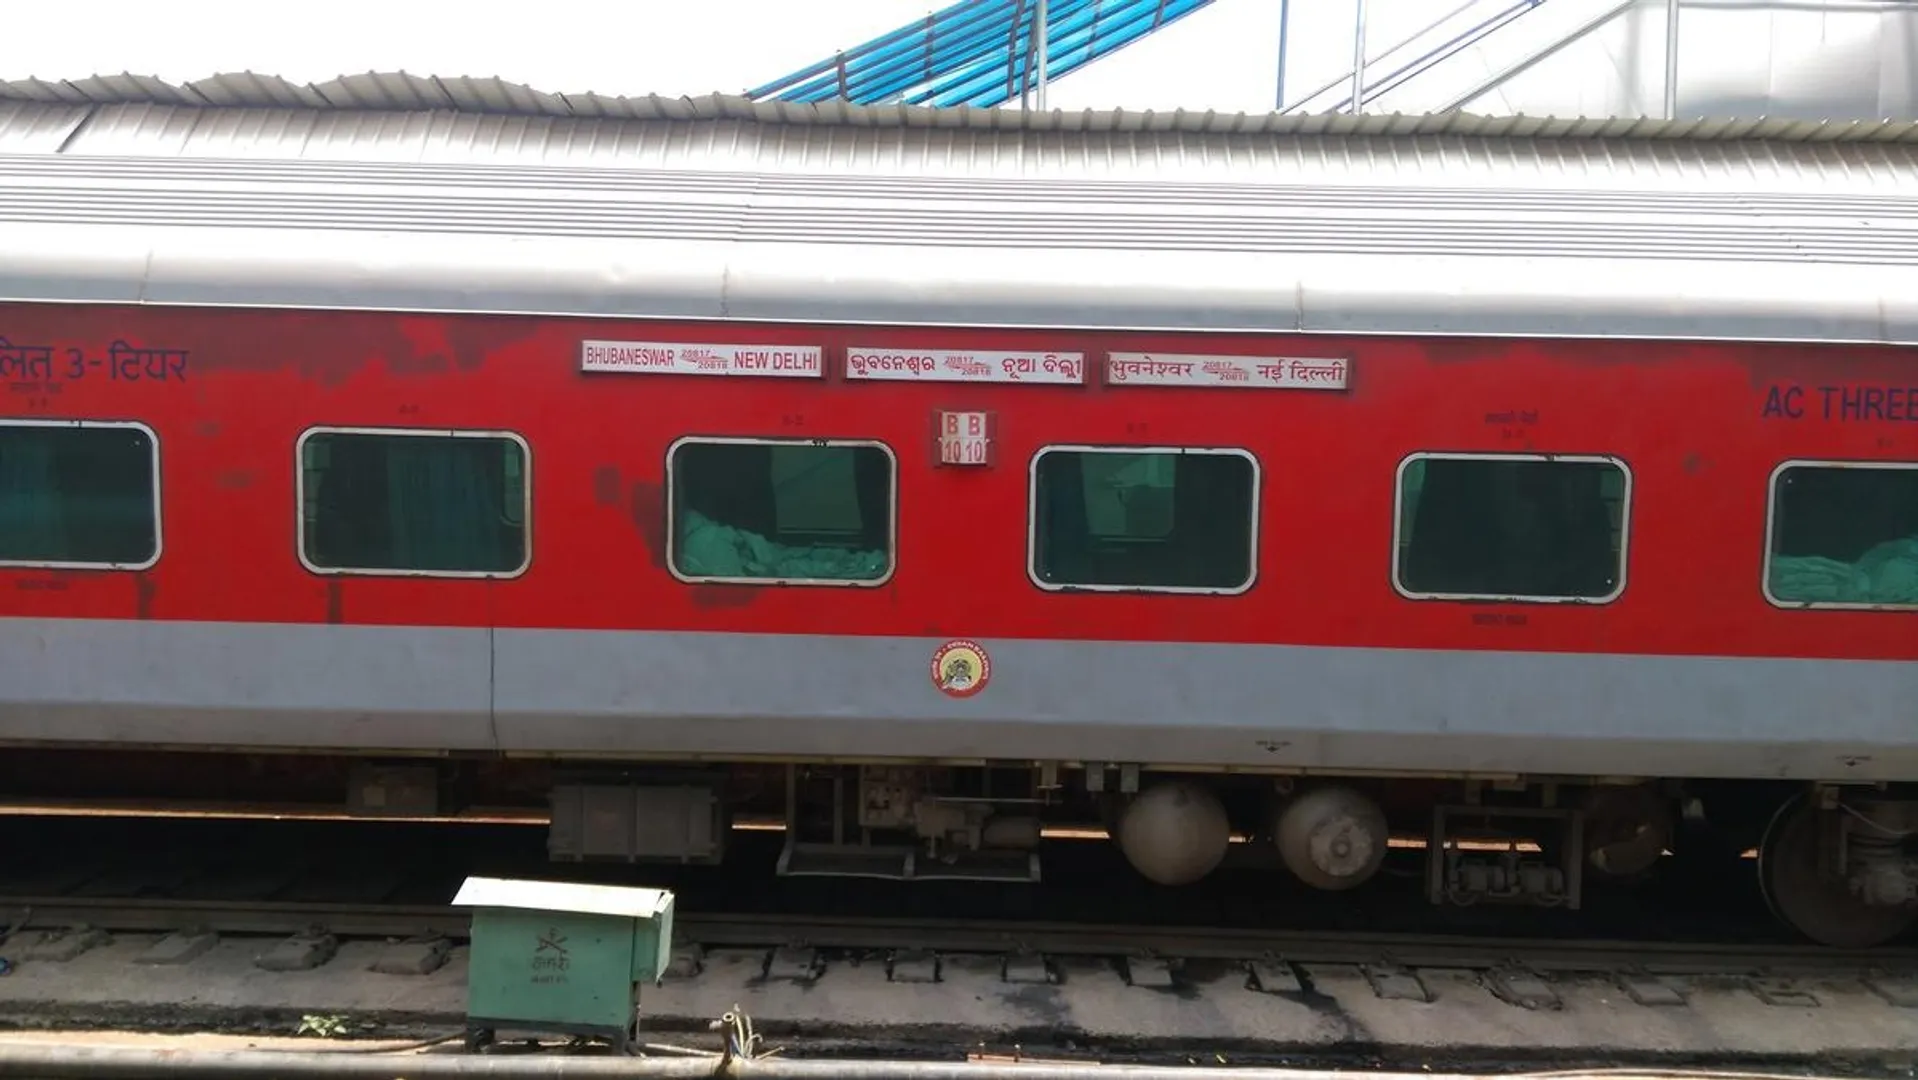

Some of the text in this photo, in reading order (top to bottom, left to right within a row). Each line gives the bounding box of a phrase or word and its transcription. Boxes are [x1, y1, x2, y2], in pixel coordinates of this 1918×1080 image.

[585, 346, 675, 367] BHUBANESWAR
[734, 350, 817, 370] NEW DELHI
[1110, 356, 1194, 380] भुवनेश्वर
[1256, 359, 1345, 382] नई दिल्ली
[1762, 385, 1918, 421] AC THREE
[947, 414, 980, 436] B B
[945, 441, 982, 462] 10 10
